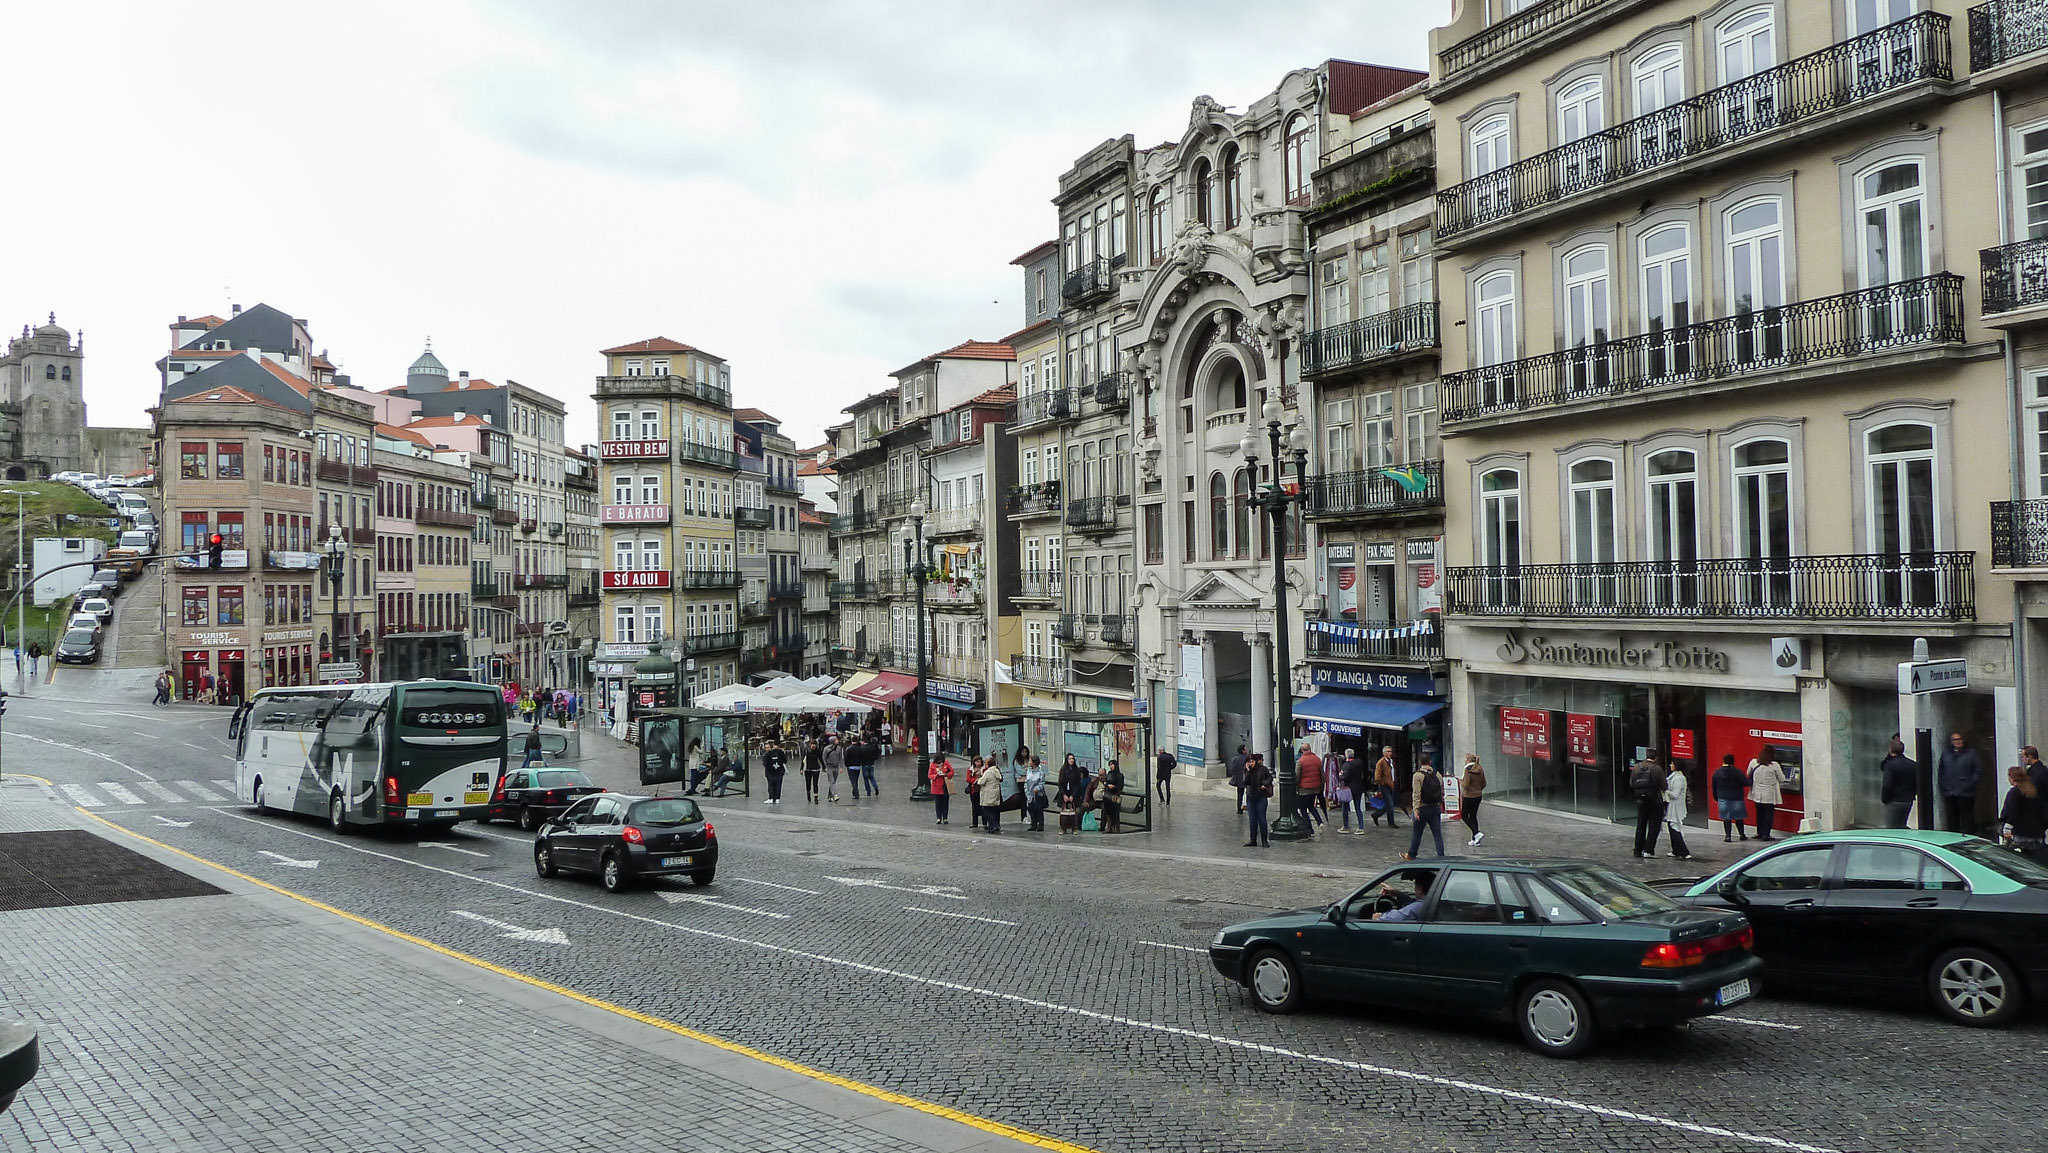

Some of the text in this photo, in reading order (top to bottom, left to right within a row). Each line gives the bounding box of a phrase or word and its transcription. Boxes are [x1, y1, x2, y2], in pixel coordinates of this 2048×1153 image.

[602, 442, 668, 456] VESTIR BEM
[606, 506, 663, 520] E BARATO
[1328, 545, 1353, 558] INTERNET
[1367, 545, 1395, 558] FAX FONE
[614, 572, 659, 586] SÓ AQUI
[190, 632, 230, 640] TOURIST
[201, 637, 240, 646] SERVICE
[264, 629, 313, 641] TOURIST SERVICE
[1530, 636, 1730, 672] Santander Totta
[1316, 669, 1408, 689] JOY BANGLA STORE
[1930, 670, 1943, 681] Ponte
[1308, 720, 1361, 735] J-B-S SOUVENIRS
